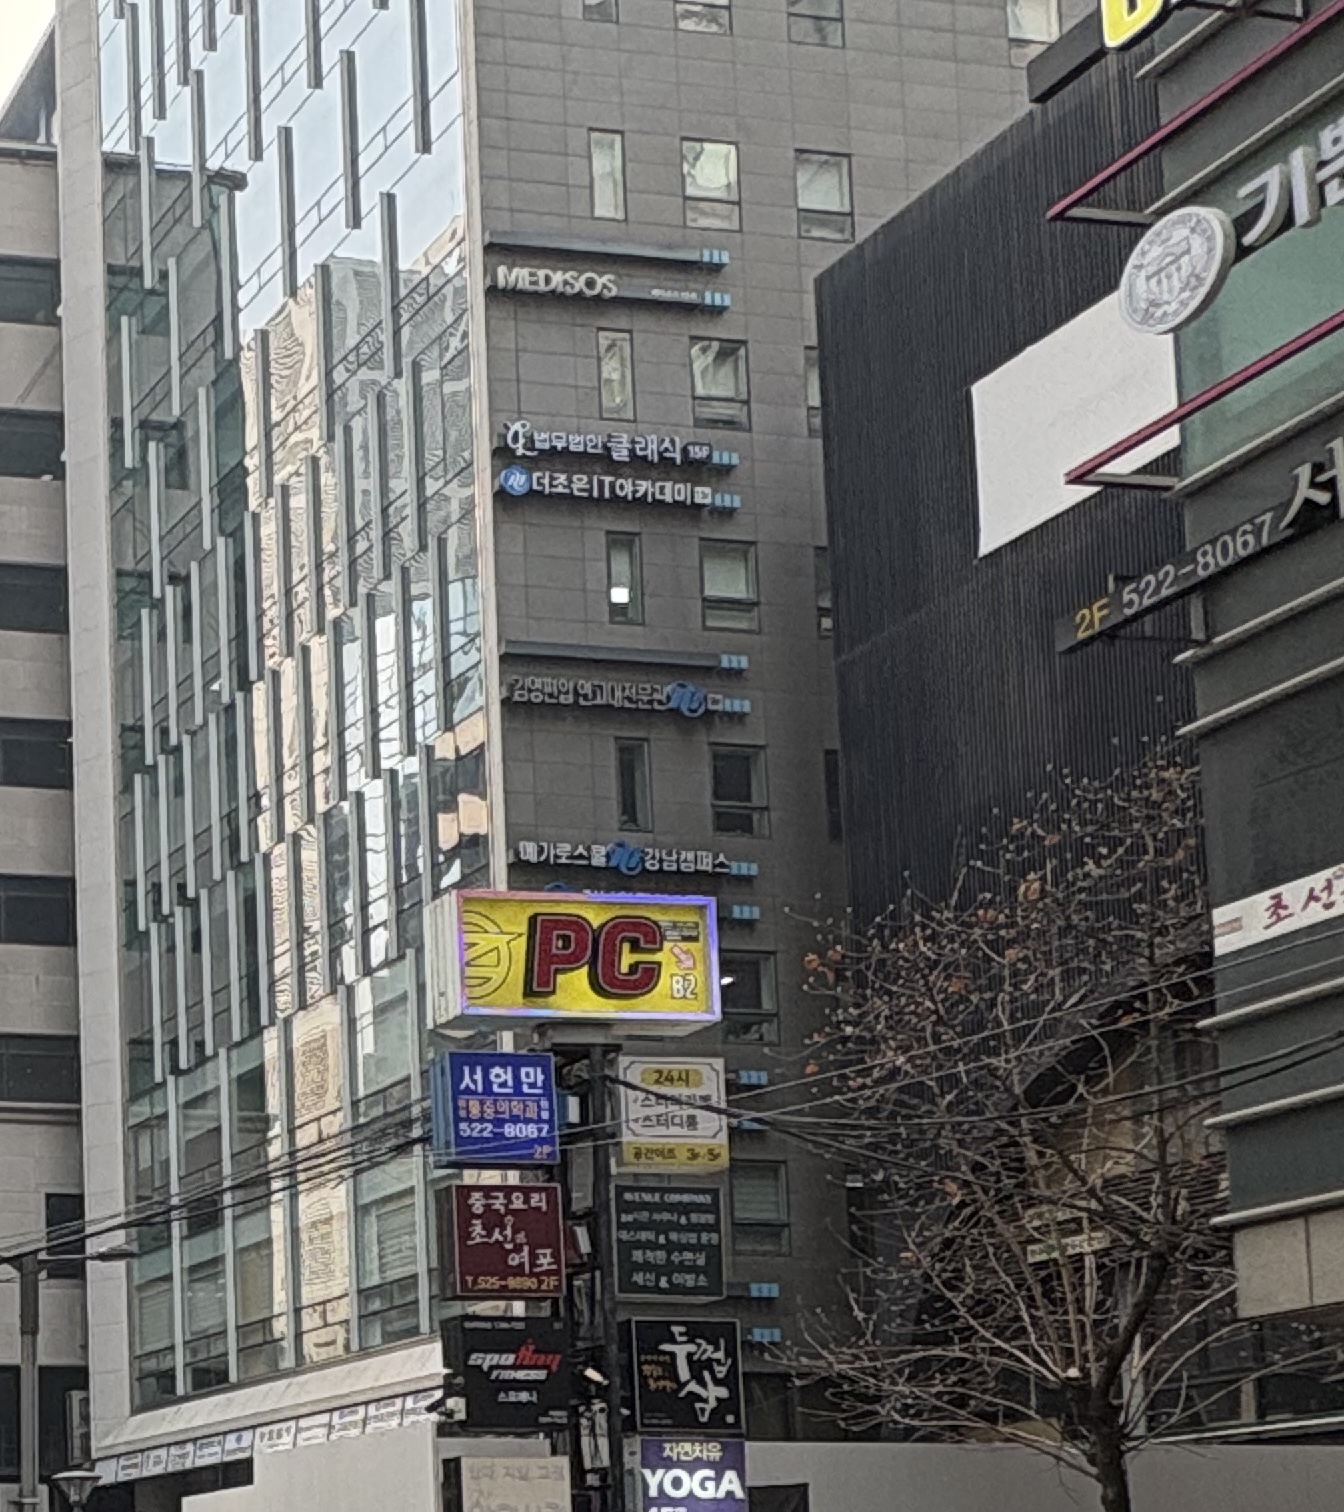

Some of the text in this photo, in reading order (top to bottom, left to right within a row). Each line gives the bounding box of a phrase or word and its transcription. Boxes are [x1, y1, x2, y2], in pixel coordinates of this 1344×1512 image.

[497, 265, 618, 299] MEDISOS
[534, 431, 604, 453] 법무법인
[607, 433, 683, 466] 클래식
[1075, 598, 1110, 640] 2F
[1122, 511, 1275, 617] 522-8067
[519, 840, 731, 873] 메가로스쿨 강남캠퍼스
[524, 913, 664, 1000] PC
[671, 973, 698, 1000] B2
[653, 1069, 690, 1088] 24시
[459, 1122, 550, 1138] 522-8067
[467, 1192, 547, 1214] 중국요리
[641, 1468, 746, 1500] YOGA
